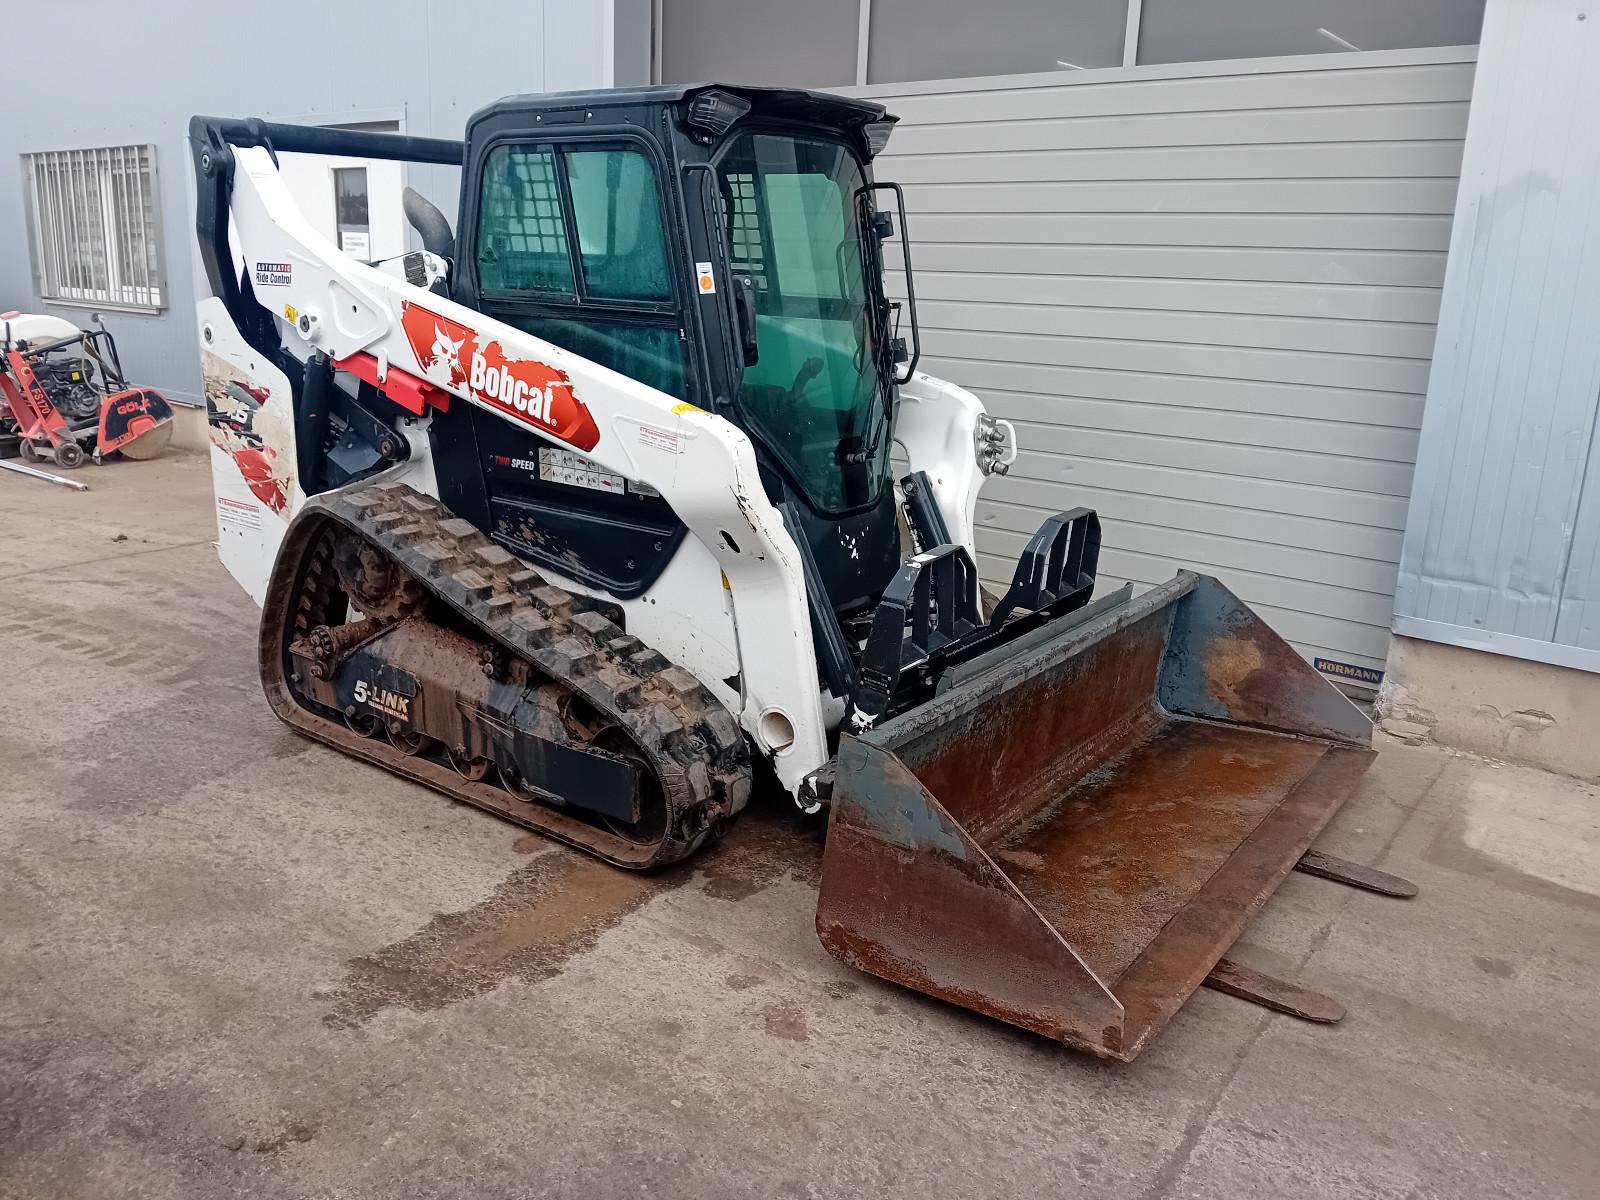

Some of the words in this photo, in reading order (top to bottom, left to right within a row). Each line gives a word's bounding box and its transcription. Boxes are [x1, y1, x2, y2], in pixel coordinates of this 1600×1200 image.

[257, 263, 292, 272] AUTOMATIC
[256, 272, 269, 283] Ride
[270, 273, 292, 284] Control
[470, 351, 554, 425] Bobcat
[31, 387, 51, 415] FS170
[511, 458, 535, 471] SPEED
[1318, 661, 1380, 681] HÖRMANN
[353, 679, 410, 714] 5-LINK
